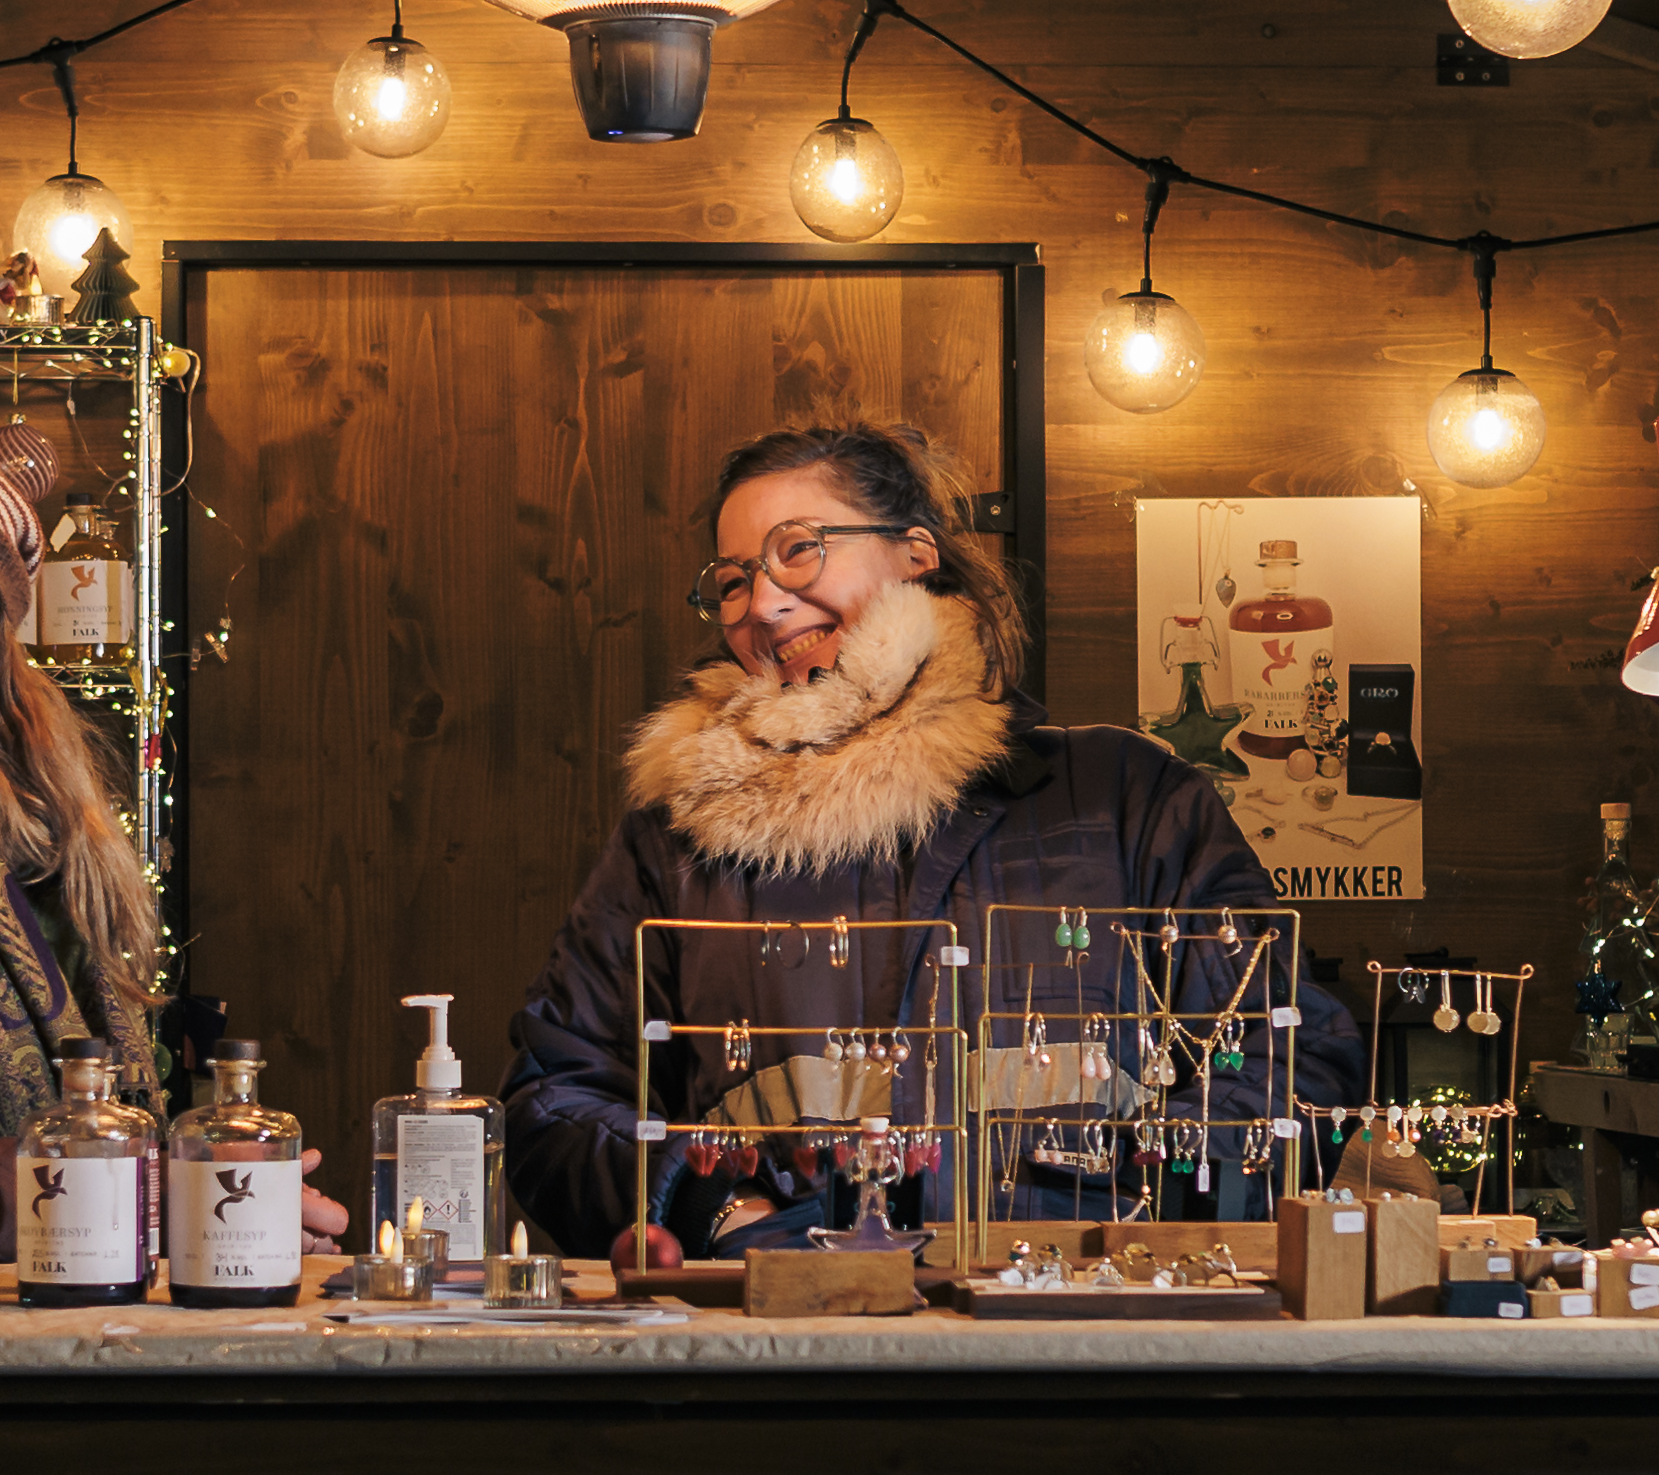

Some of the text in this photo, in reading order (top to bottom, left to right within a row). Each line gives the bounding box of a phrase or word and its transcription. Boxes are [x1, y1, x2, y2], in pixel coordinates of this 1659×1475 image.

[72, 629, 99, 637] FALK
[1360, 687, 1399, 699] GRO
[1264, 719, 1298, 729] FALK
[203, 1230, 267, 1241] KAFFESYP
[33, 1261, 67, 1273] FALK
[214, 1265, 254, 1277] FALK
